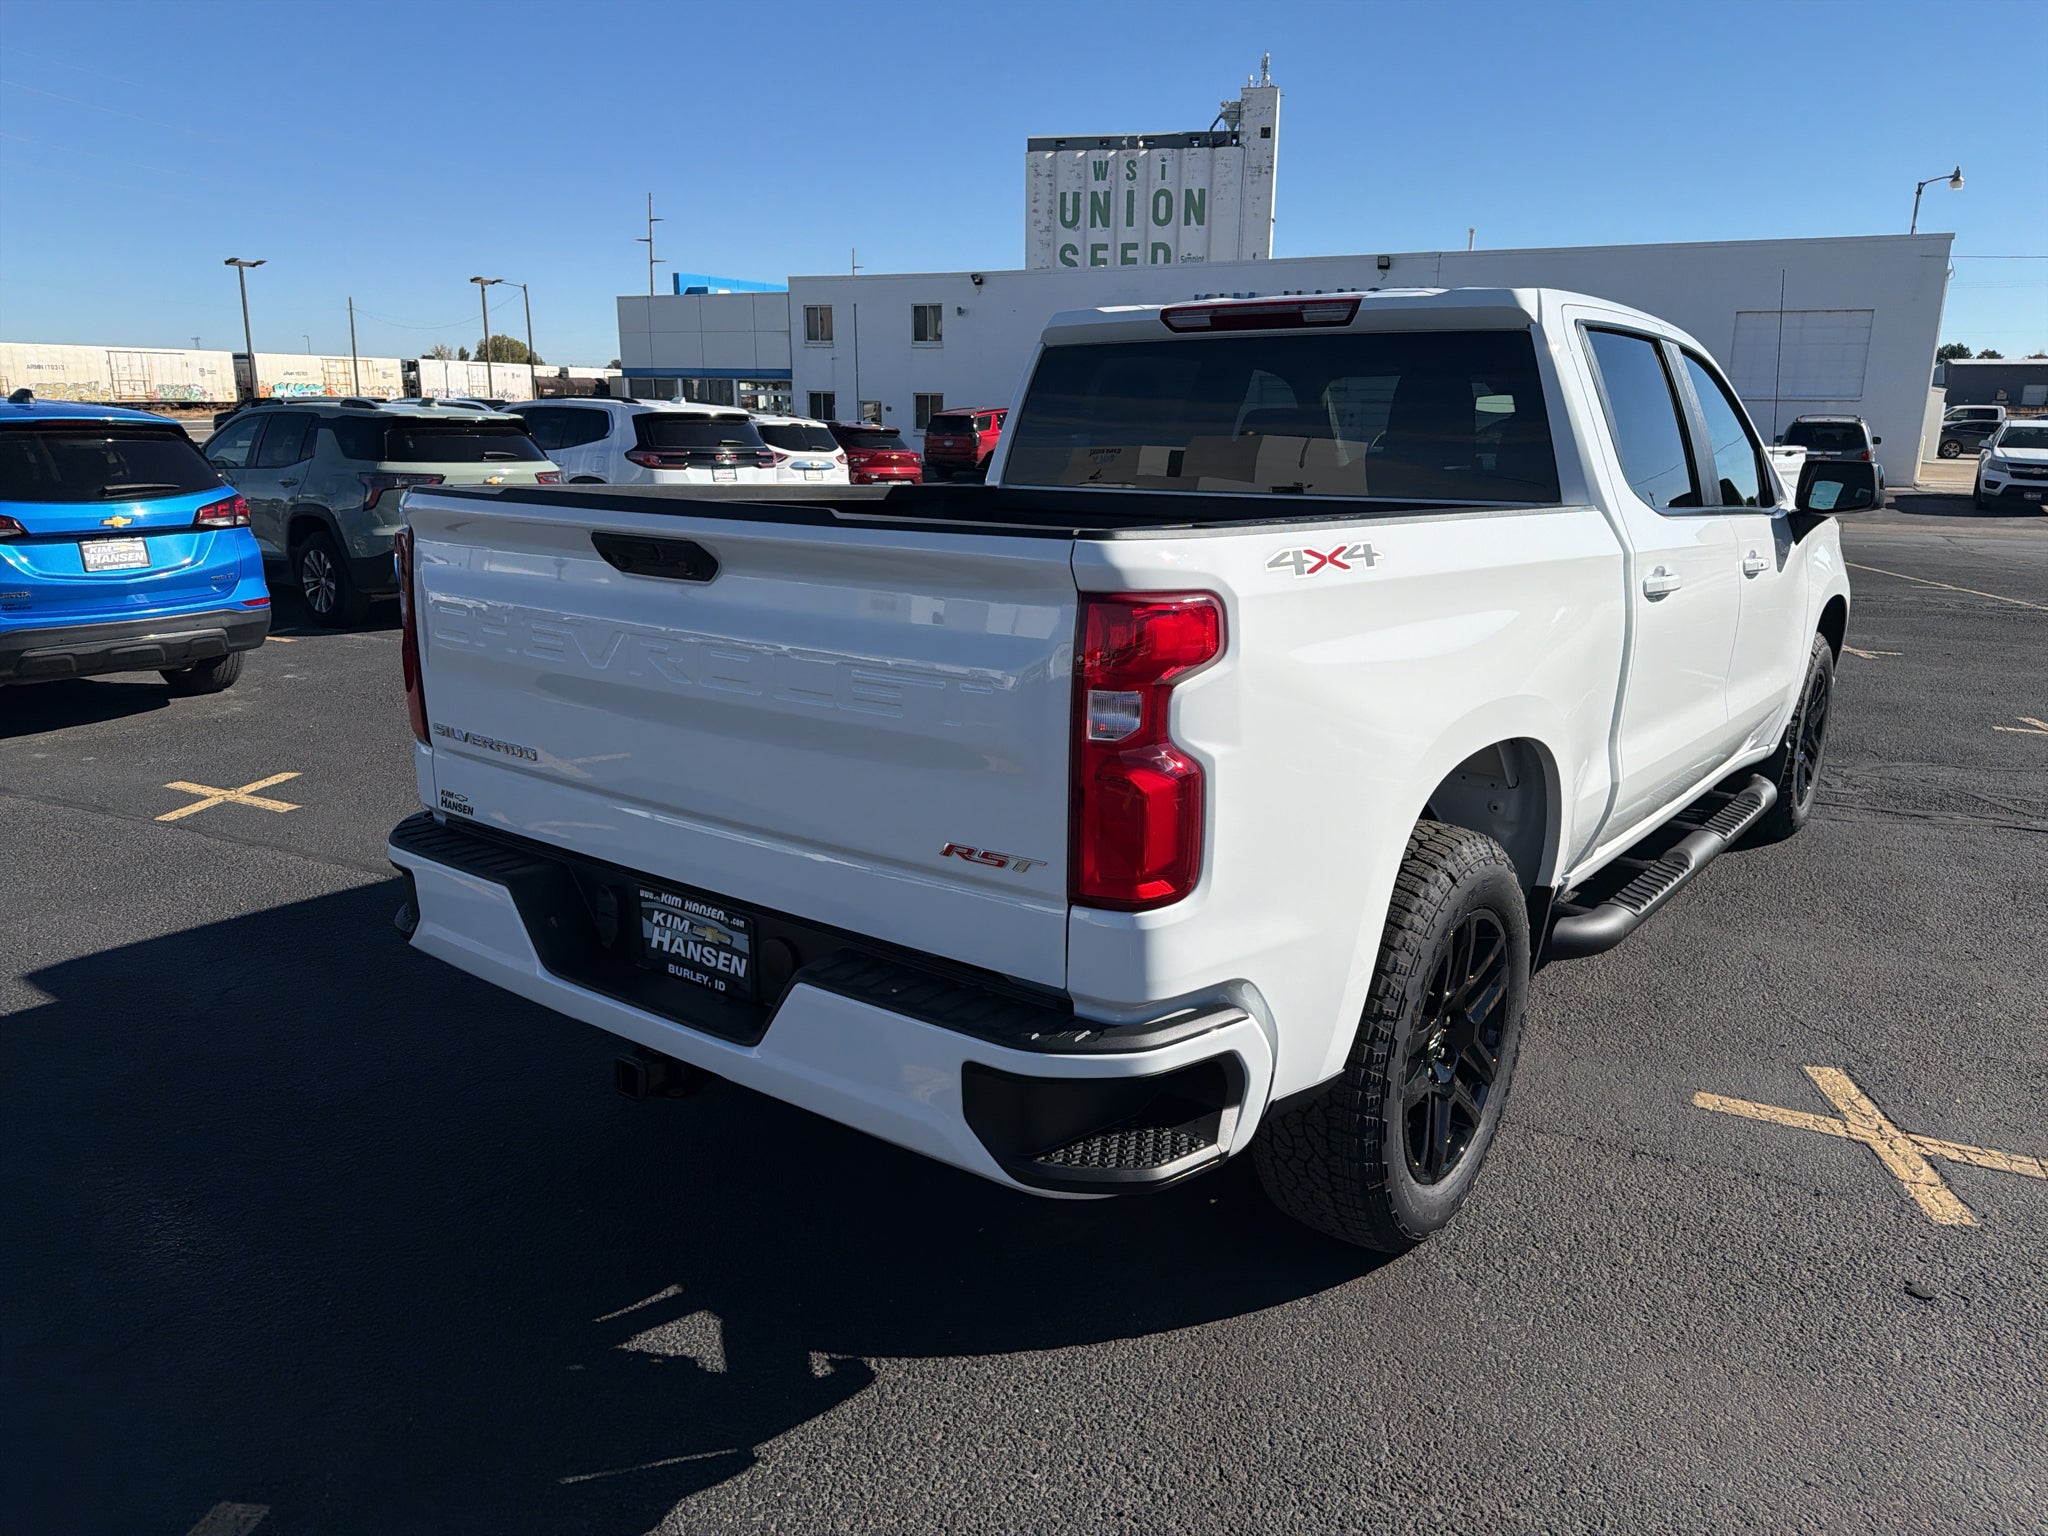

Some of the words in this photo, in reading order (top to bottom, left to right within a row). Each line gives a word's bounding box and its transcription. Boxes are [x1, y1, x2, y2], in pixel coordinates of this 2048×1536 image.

[1059, 188, 1206, 229] UNION
[89, 546, 112, 554] KIM
[90, 551, 144, 564] HANSEN
[430, 601, 1010, 727] CHEVROLET
[432, 722, 538, 761] SILVERADO
[441, 789, 454, 801] KIM
[441, 796, 474, 816] HANSEN
[939, 841, 1048, 873] RST
[661, 892, 682, 908] KIM
[684, 899, 724, 921] HANSEN
[652, 910, 690, 933] KIM
[651, 926, 747, 978] HANSEN
[668, 963, 712, 988] BURLEY,
[714, 979, 726, 991] ID
